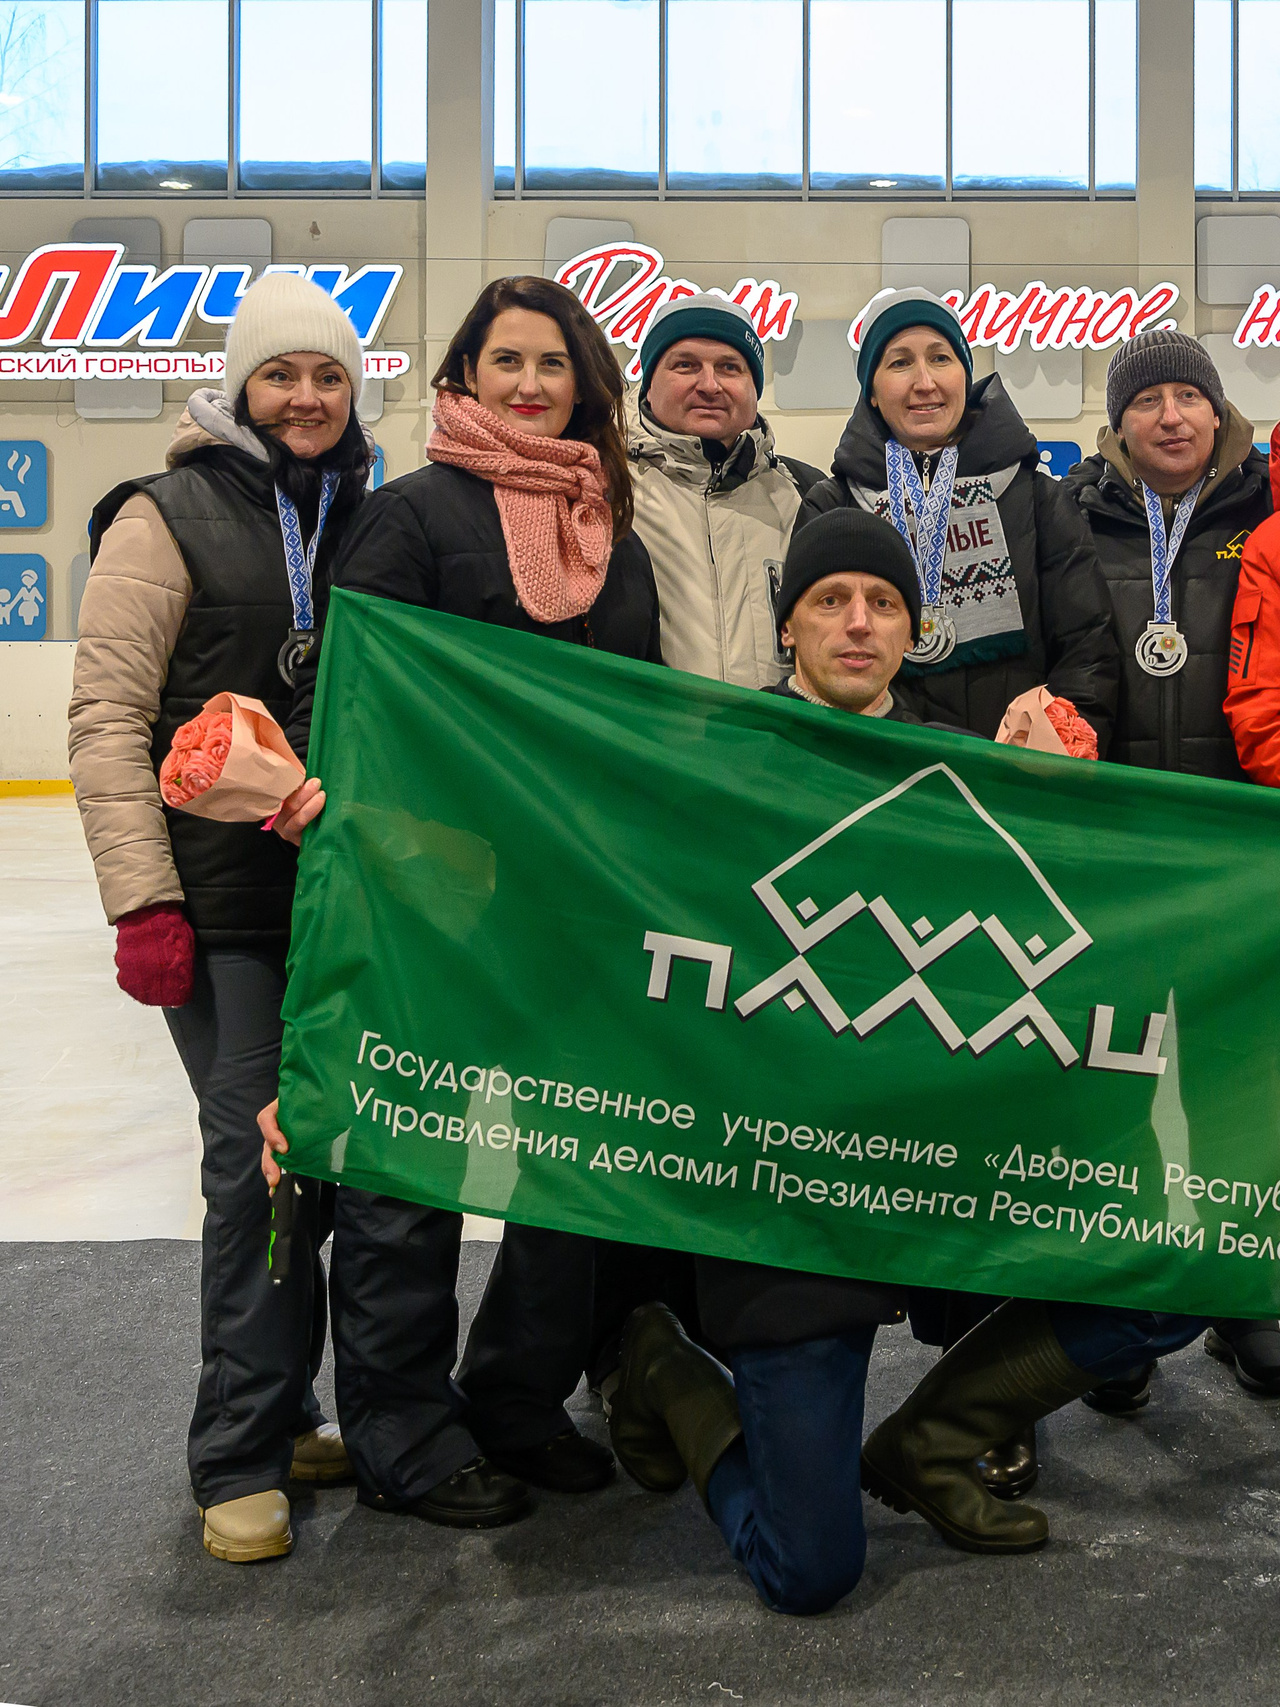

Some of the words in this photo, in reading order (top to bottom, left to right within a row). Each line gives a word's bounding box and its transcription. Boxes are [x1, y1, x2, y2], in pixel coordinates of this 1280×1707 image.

[349, 1081, 580, 1163] Управления
[588, 1142, 739, 1189] делами
[751, 1159, 979, 1219] Президента
[988, 1190, 1206, 1251] Республики
[356, 1030, 696, 1130] Государственное
[721, 1111, 959, 1168] учреждение
[983, 1144, 1140, 1195] «Дворец
